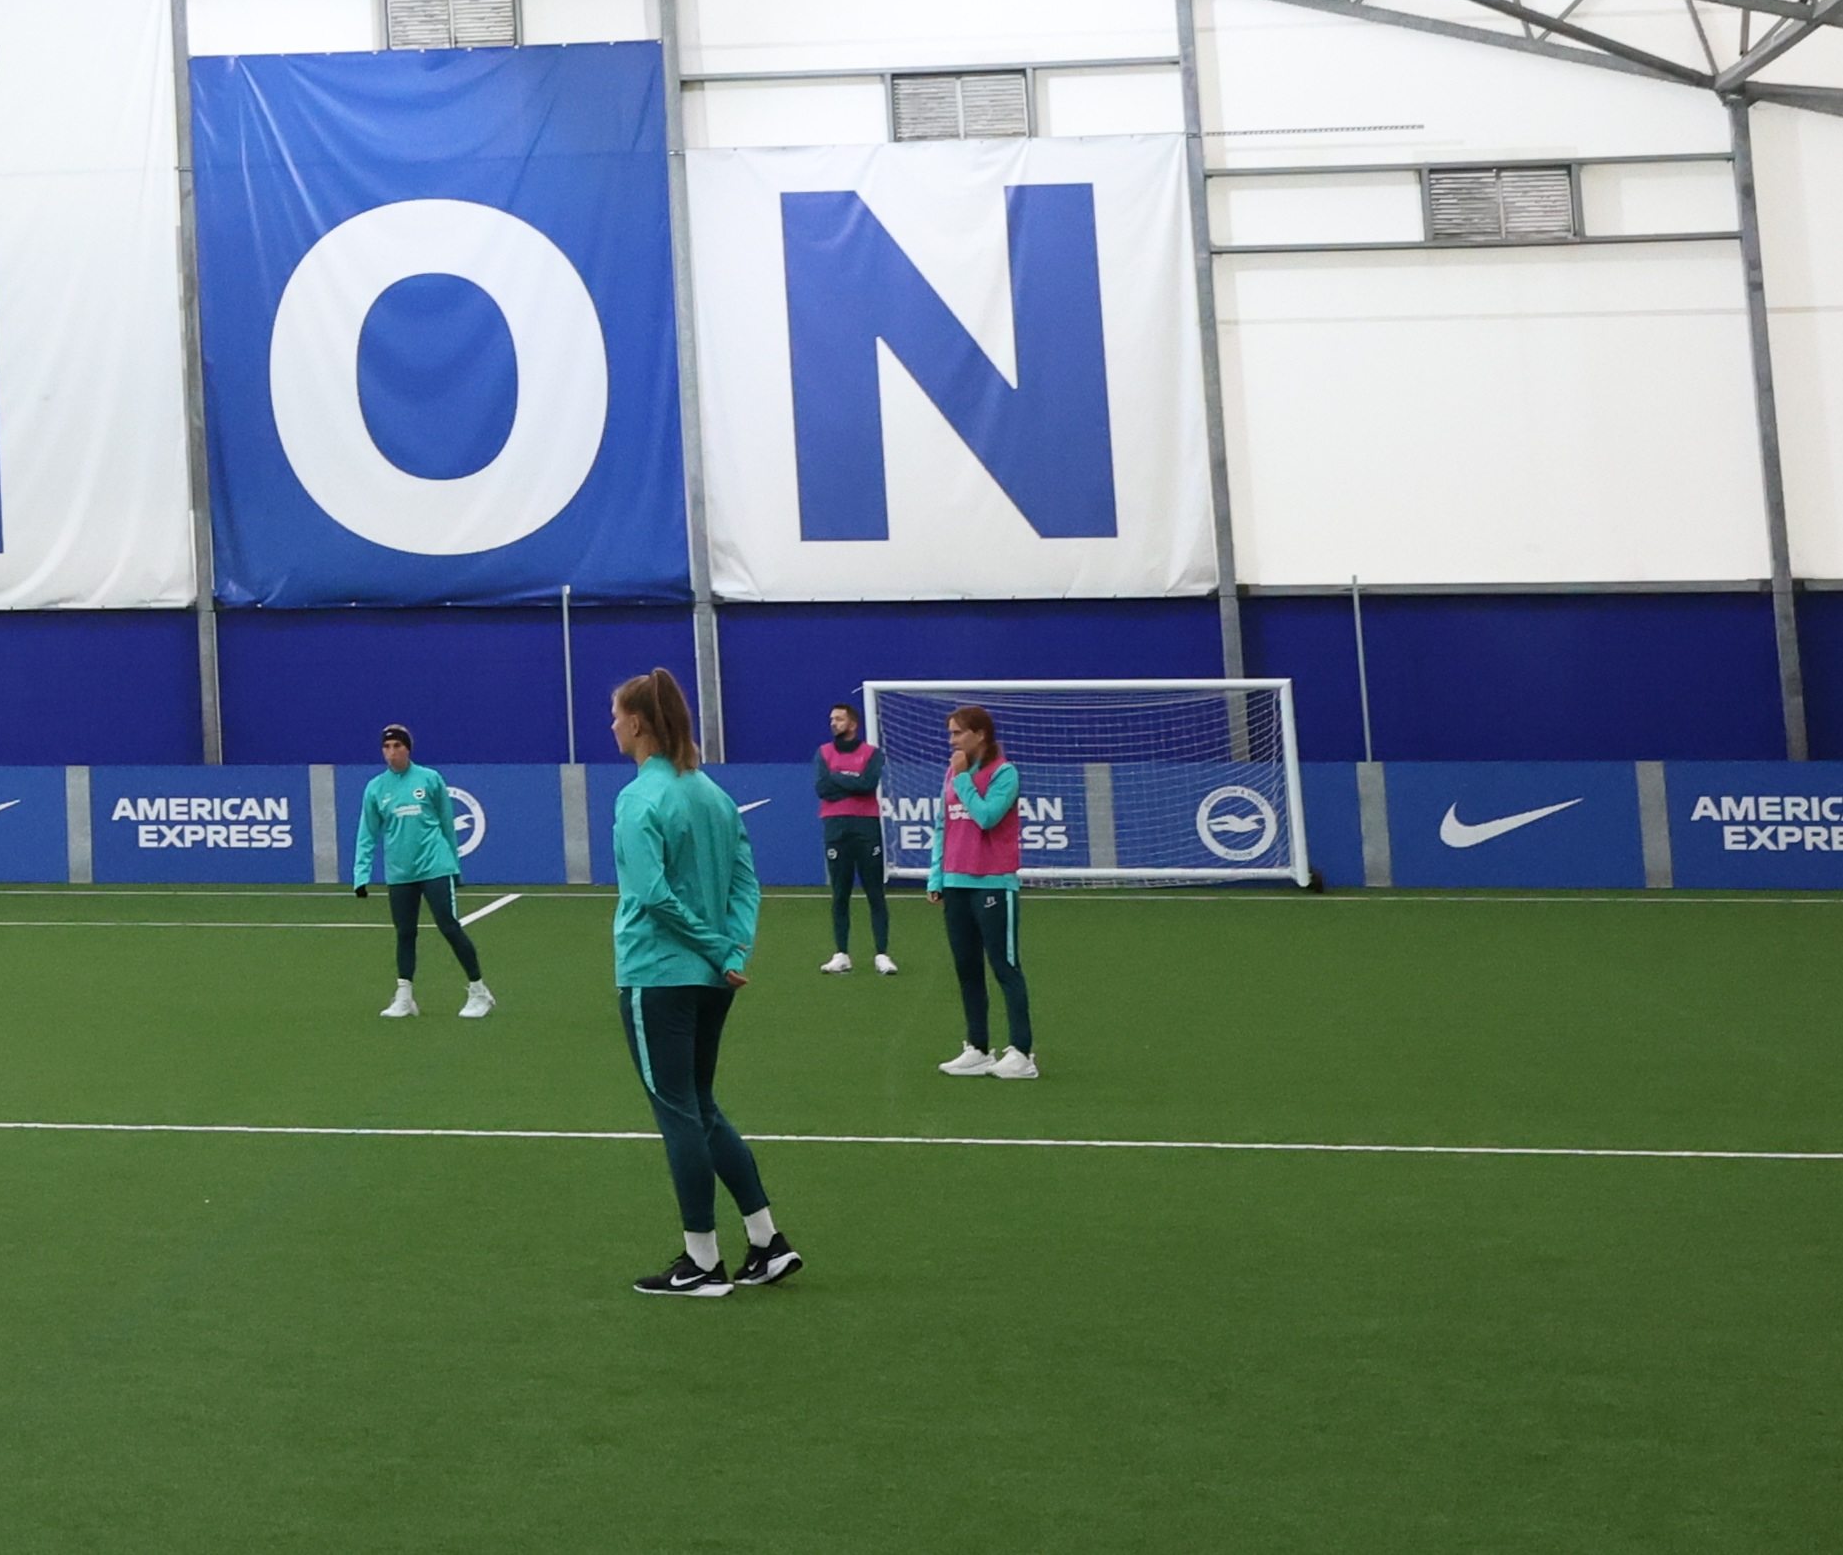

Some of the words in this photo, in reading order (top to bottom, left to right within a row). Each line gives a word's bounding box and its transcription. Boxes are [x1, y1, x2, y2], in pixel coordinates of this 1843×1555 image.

[111, 797, 288, 821] AMERICAN
[1690, 796, 1843, 821] AMERIC
[138, 825, 293, 848] EXPRESS
